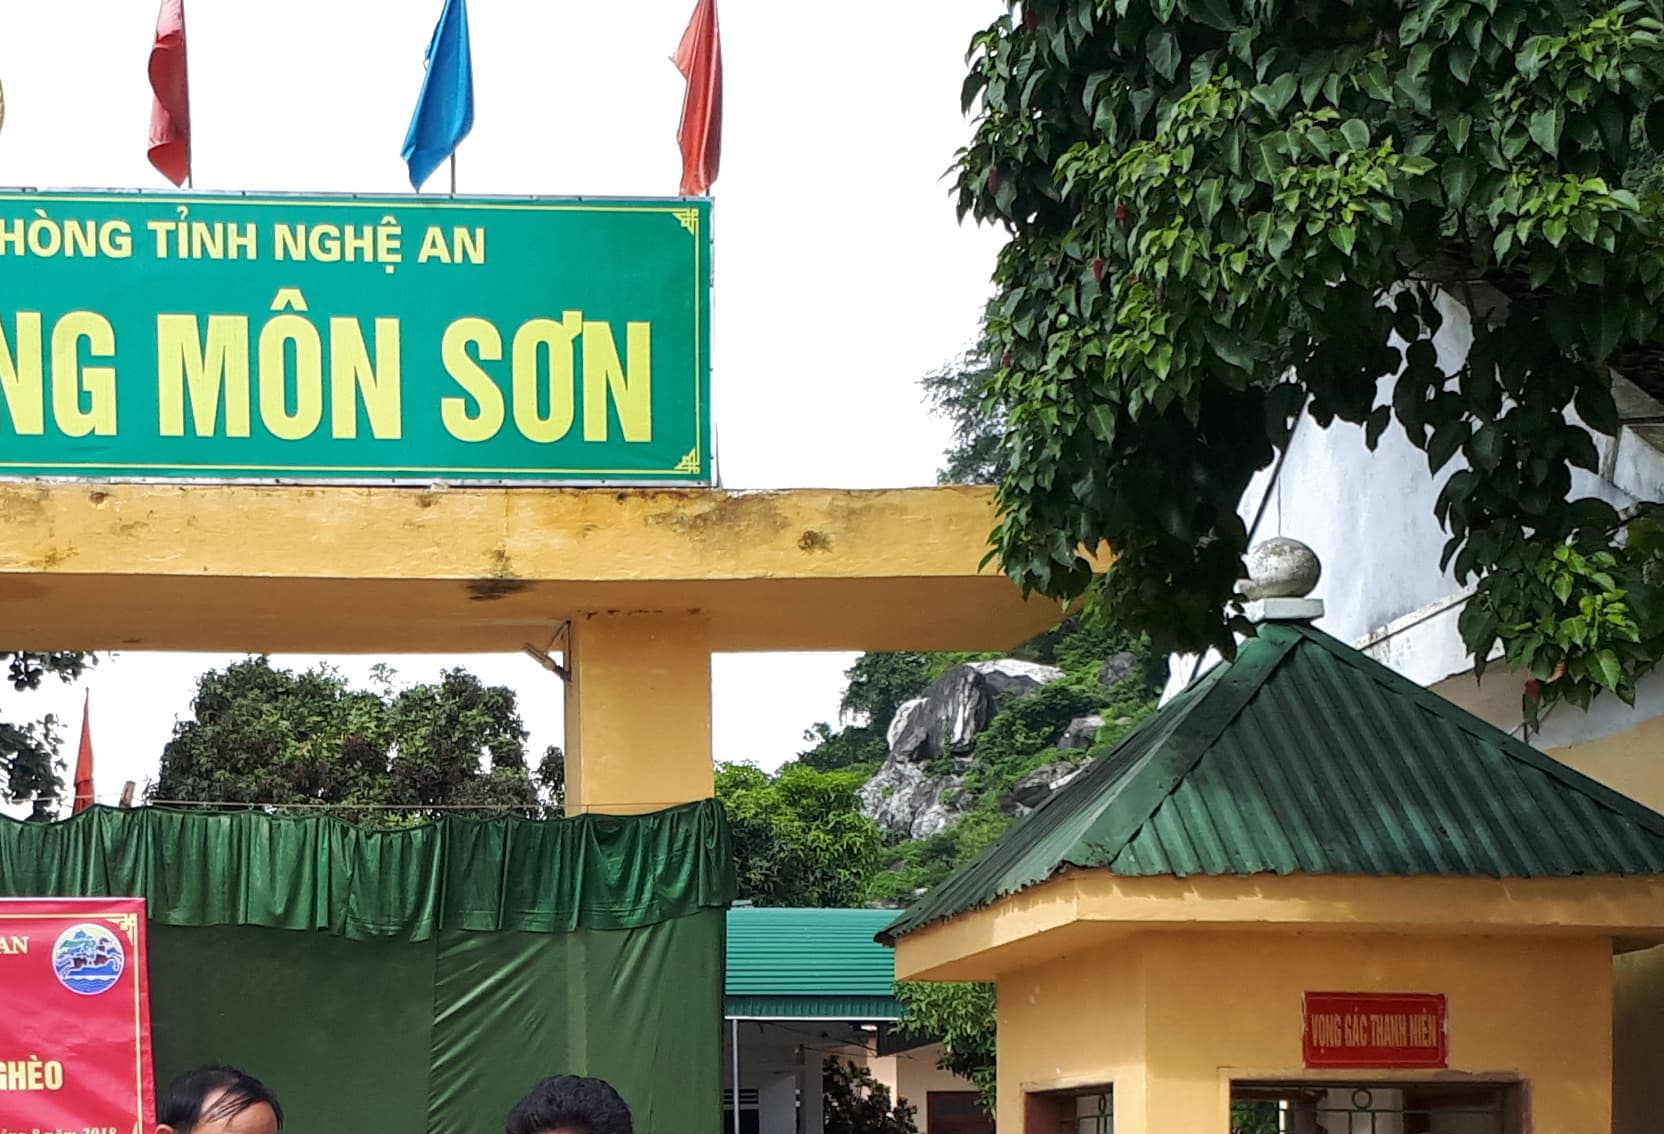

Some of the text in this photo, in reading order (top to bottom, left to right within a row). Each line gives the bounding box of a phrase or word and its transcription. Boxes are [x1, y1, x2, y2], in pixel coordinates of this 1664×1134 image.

[147, 206, 257, 261] TỈNH
[273, 215, 403, 274] NGHỆ
[416, 226, 485, 265] AN
[156, 288, 402, 440] MÔN
[441, 310, 651, 444] SƠN
[1344, 1006, 1368, 1047] GÁC
[1369, 1013, 1407, 1048] THANH
